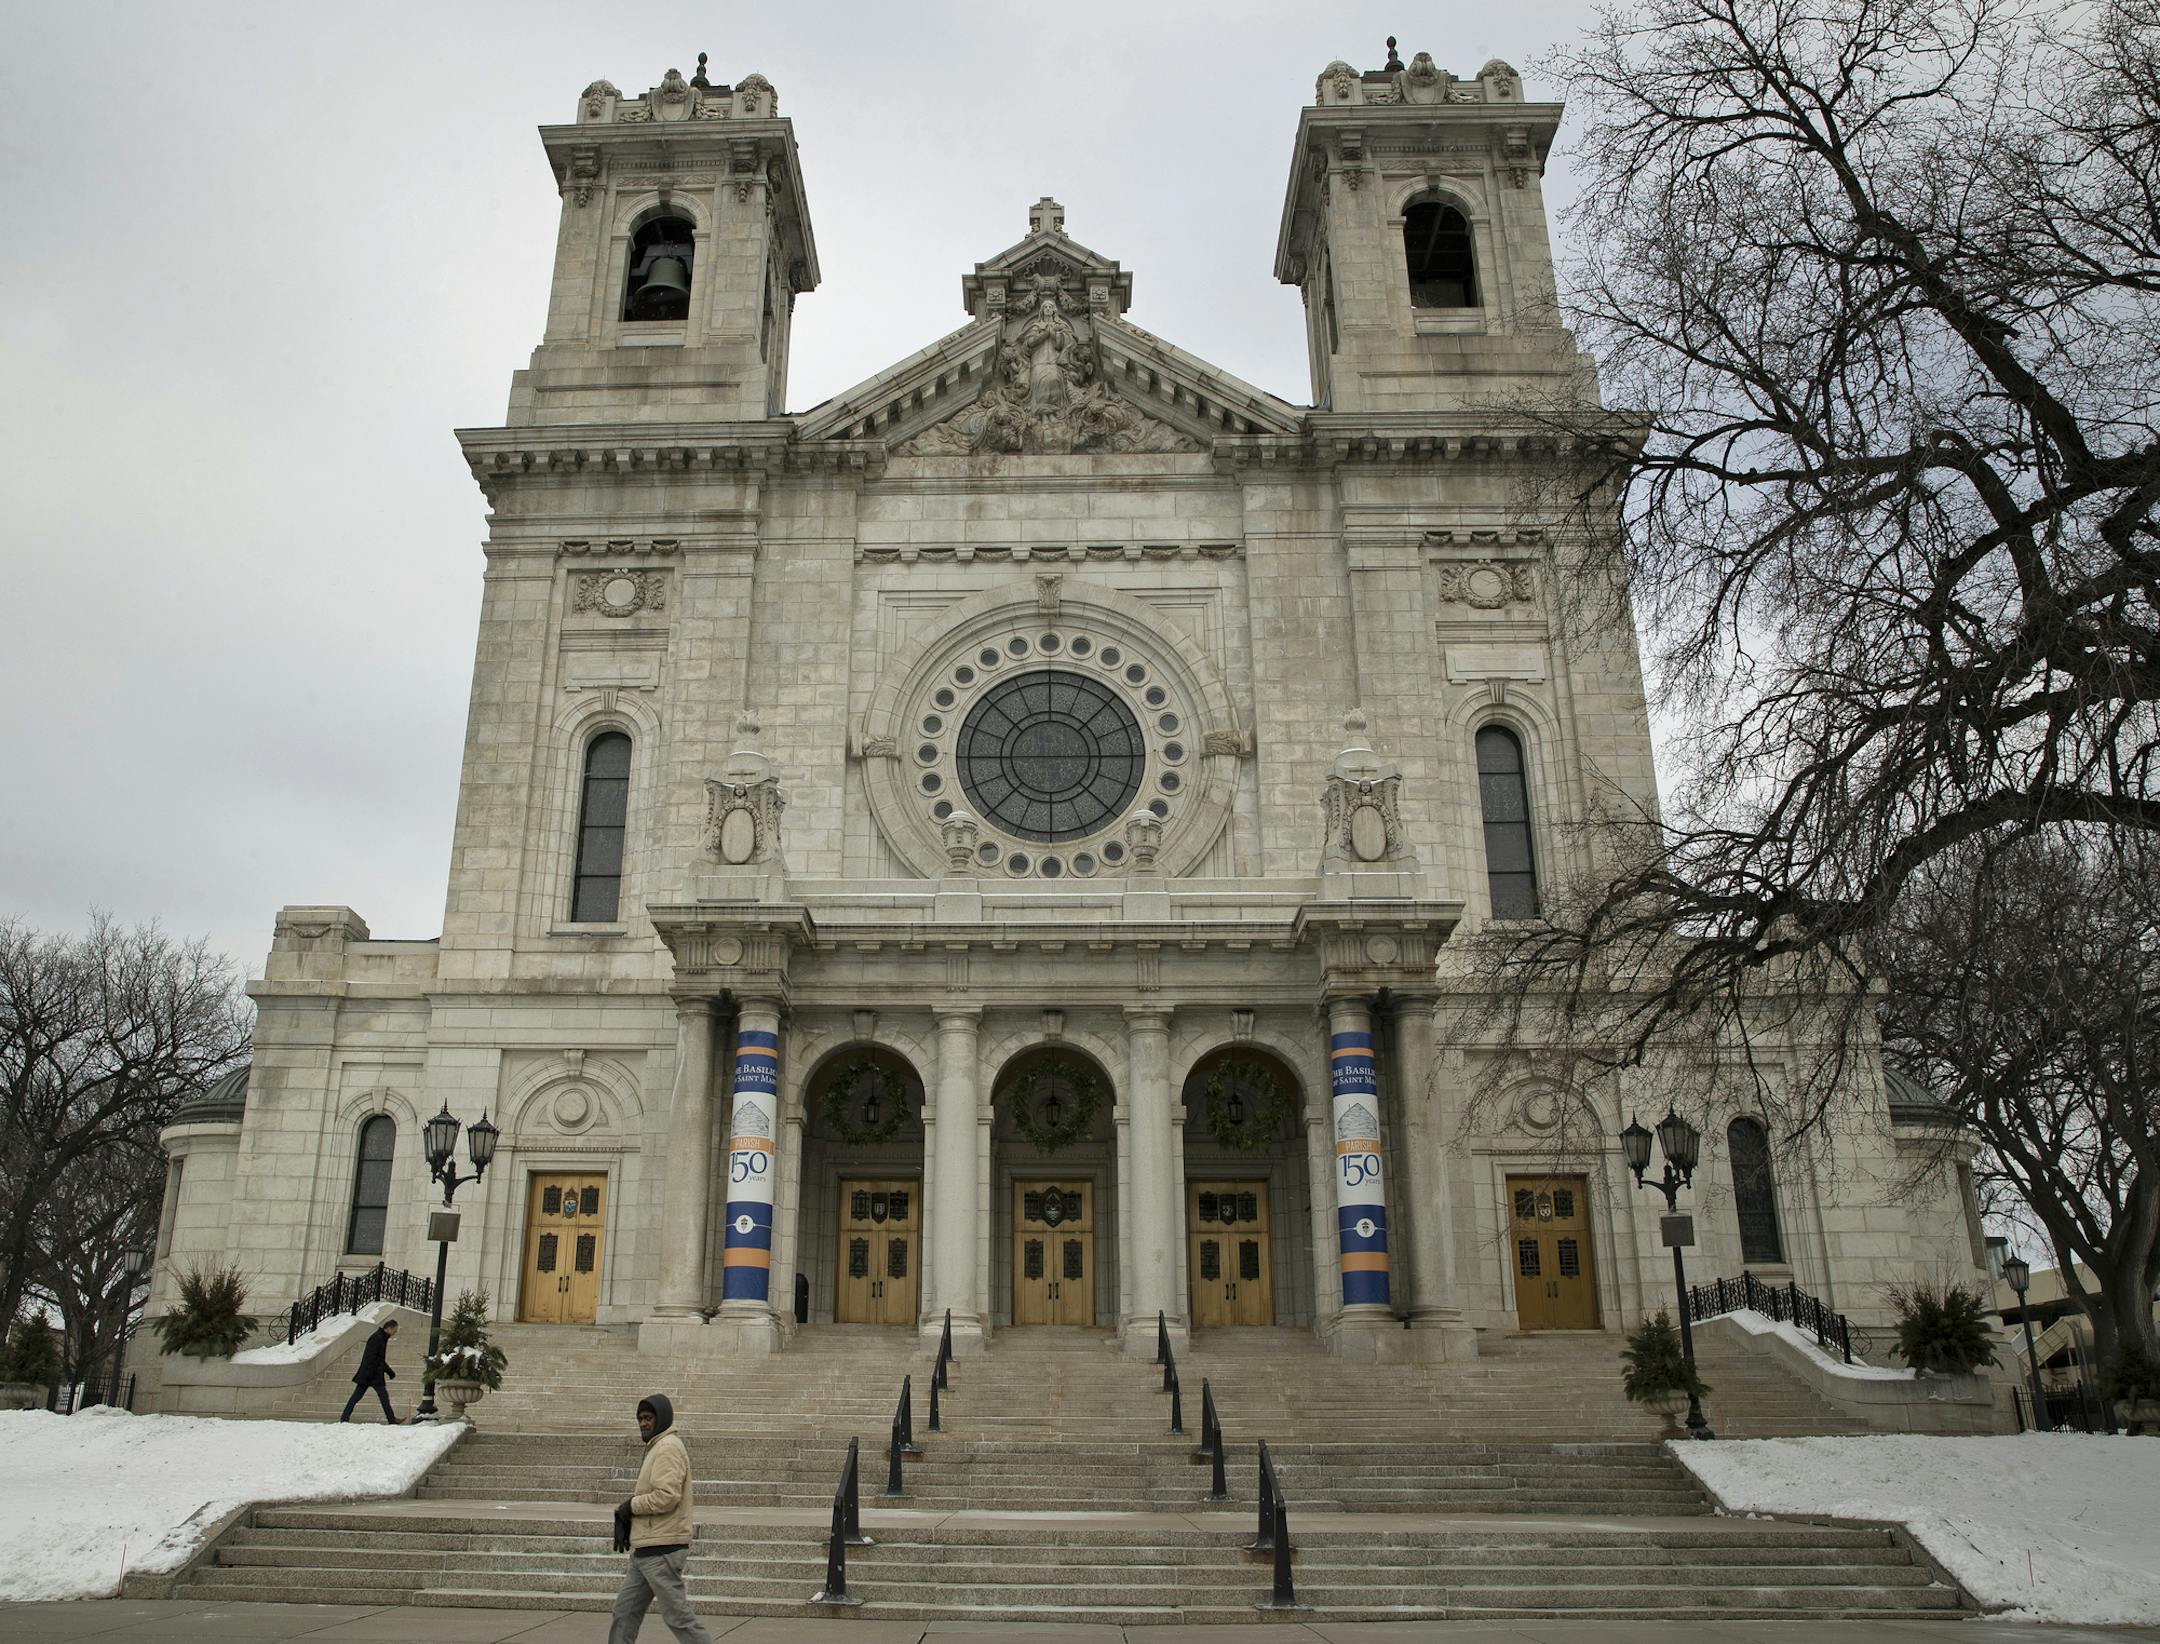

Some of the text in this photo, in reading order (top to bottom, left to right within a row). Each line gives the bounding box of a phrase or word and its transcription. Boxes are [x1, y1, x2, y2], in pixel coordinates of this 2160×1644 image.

[1340, 1076, 1364, 1085] SAINT
[735, 1137, 760, 1150] PARISH
[1344, 1140, 1373, 1152] PARISH
[730, 1151, 768, 1183] 150
[1339, 1154, 1380, 1186] 150
[747, 1175, 767, 1184] years
